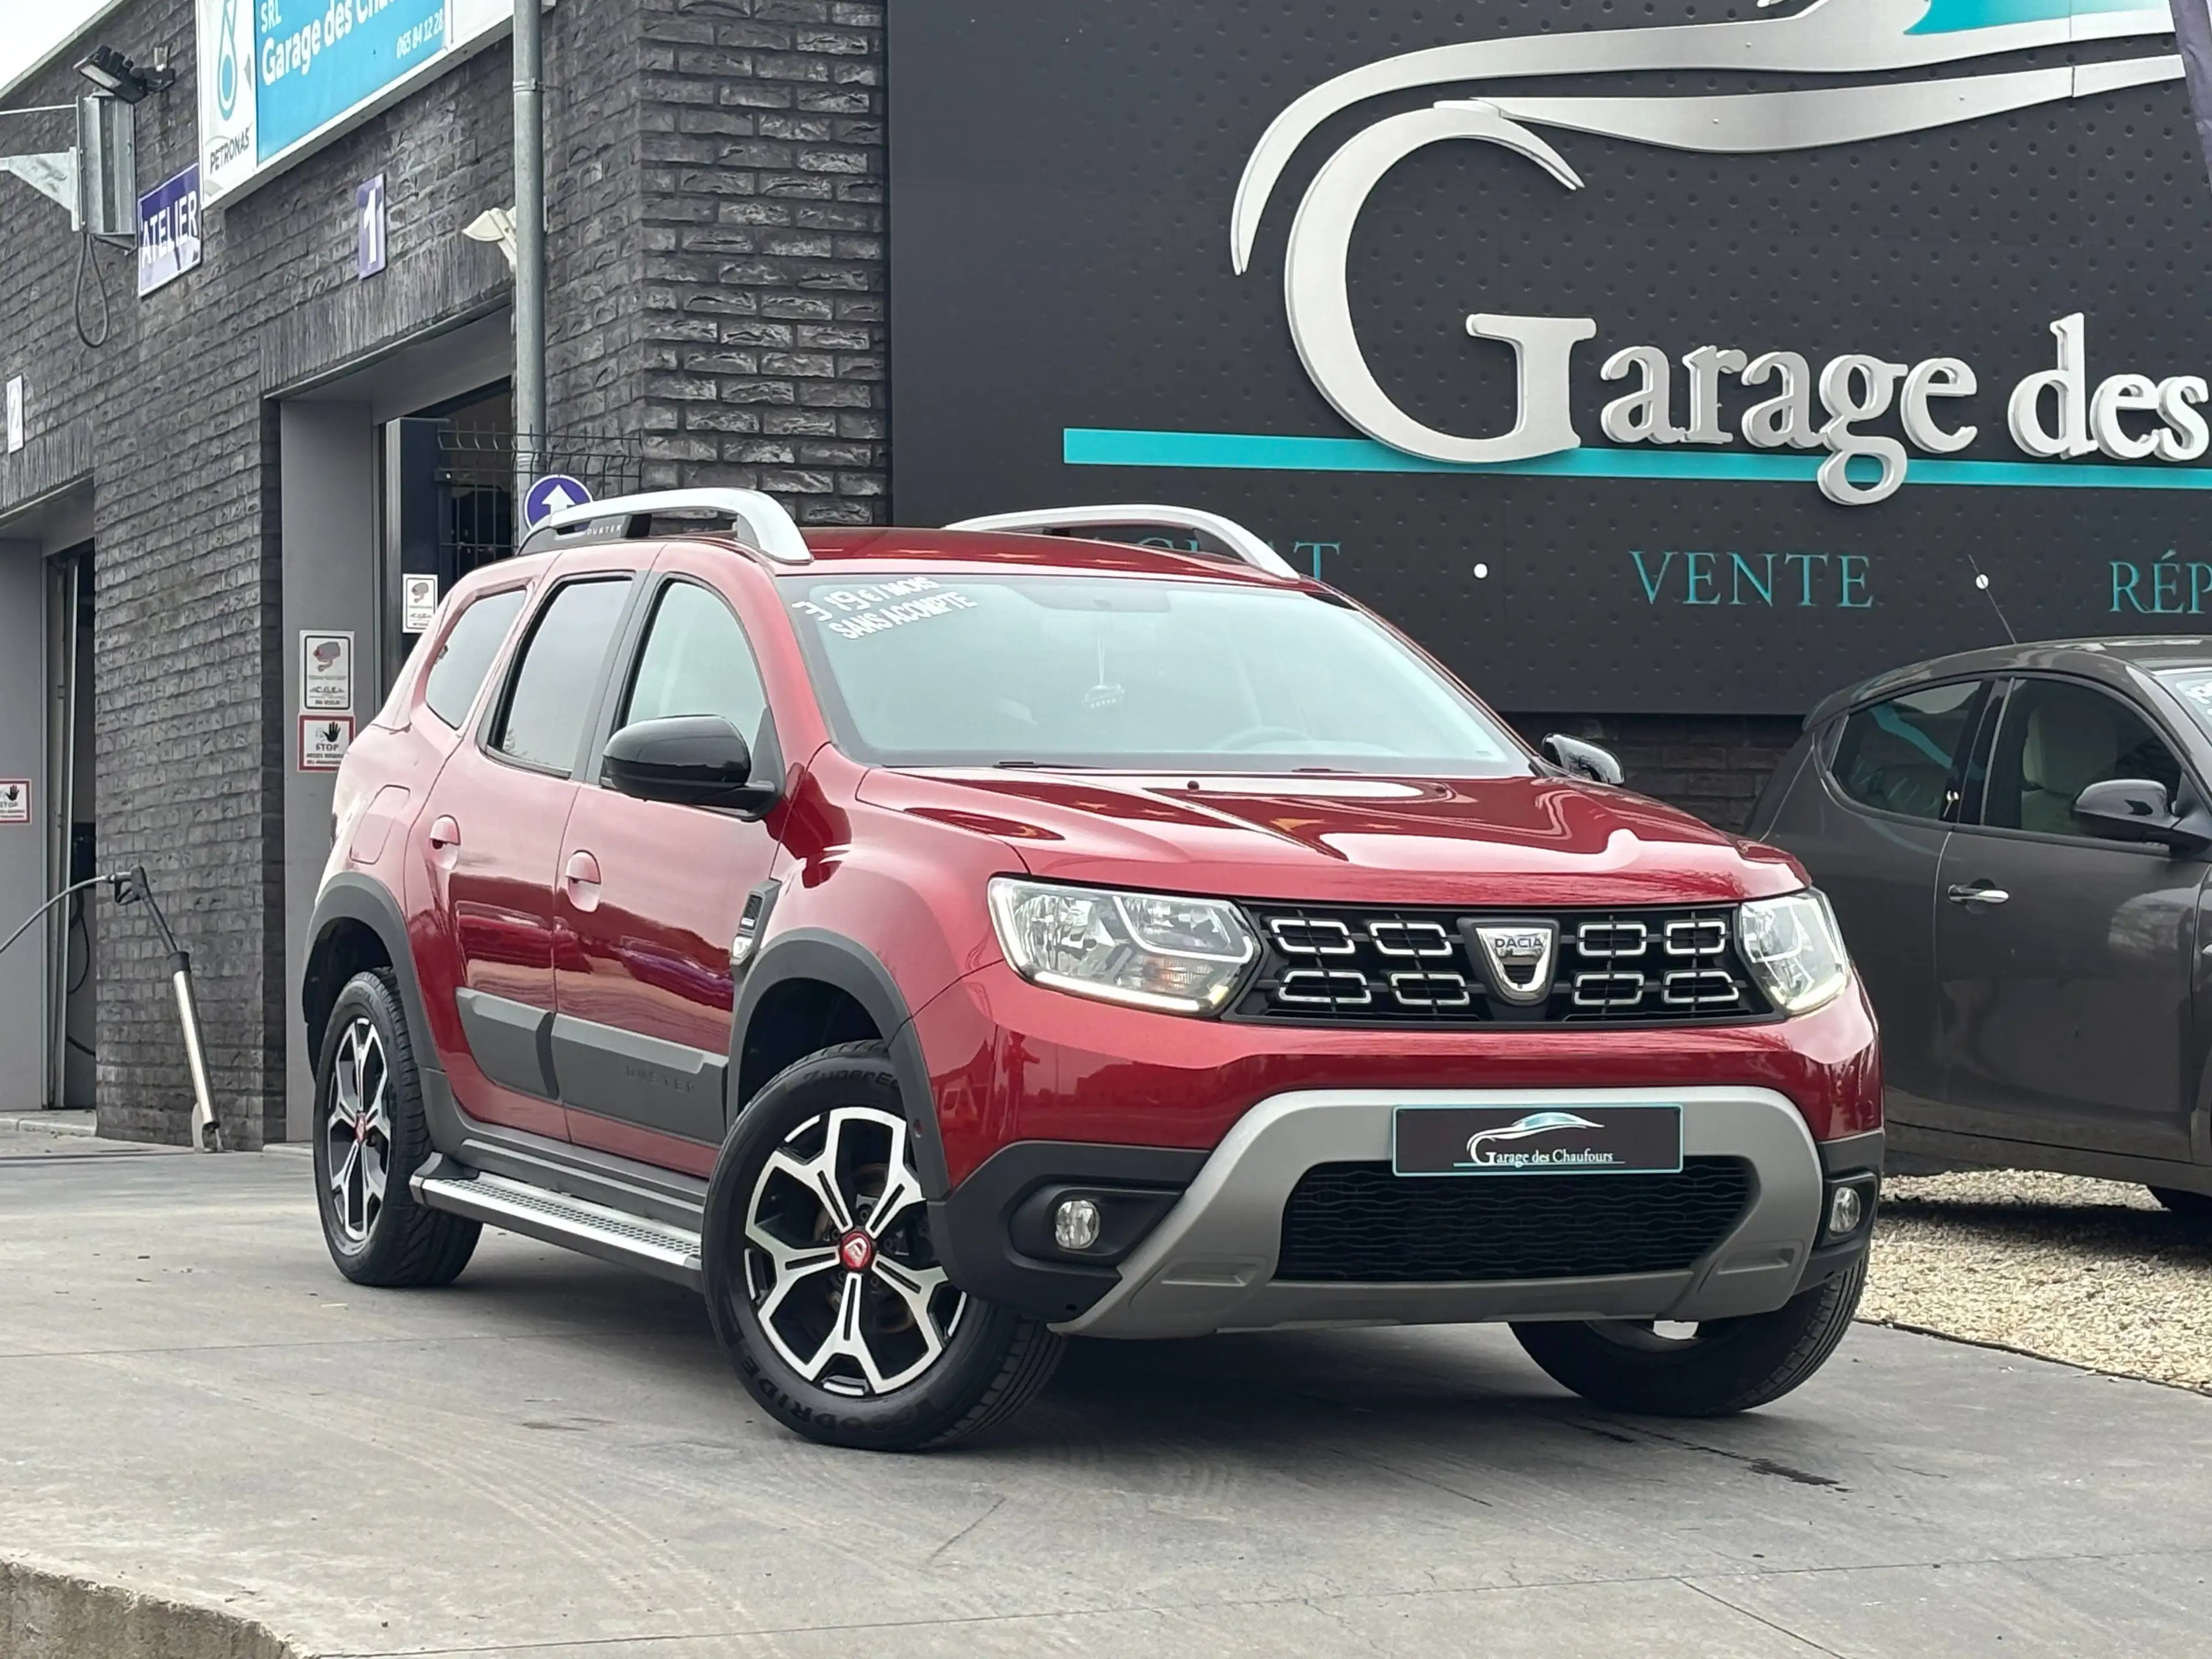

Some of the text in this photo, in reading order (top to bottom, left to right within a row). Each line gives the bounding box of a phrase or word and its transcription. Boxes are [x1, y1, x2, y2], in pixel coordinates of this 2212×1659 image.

[261, 0, 282, 33] SRL
[262, 19, 321, 86] Garage
[324, 0, 353, 47] des
[210, 127, 250, 175] PETRONAS
[141, 190, 198, 268] ATELIER
[363, 188, 377, 263] 1
[1284, 99, 2211, 506] Garage des
[1629, 550, 1874, 608] VENTE
[828, 592, 978, 640] SANS ACOMPTE
[315, 743, 340, 752] STOP
[1495, 938, 1544, 948] DACIA
[1470, 1136, 1614, 1168] Garage des Chaufours
